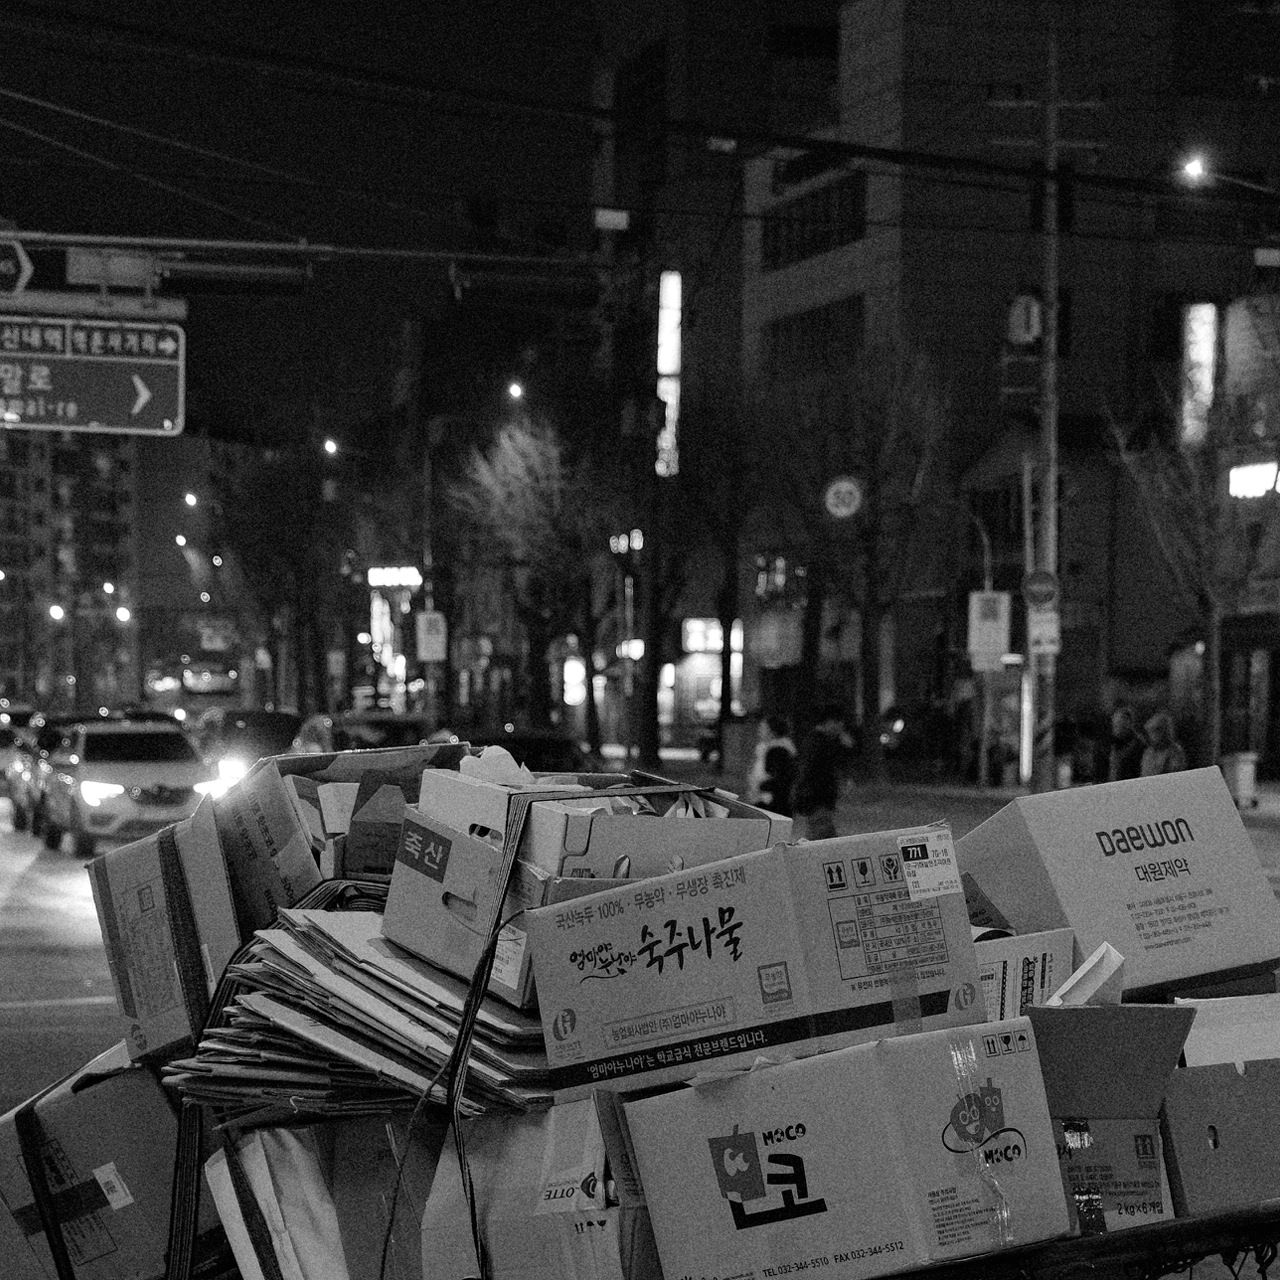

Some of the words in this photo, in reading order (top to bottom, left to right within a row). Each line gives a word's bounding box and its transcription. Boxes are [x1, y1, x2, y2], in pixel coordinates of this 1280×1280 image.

[405, 831, 443, 869] 축산
[1134, 857, 1192, 883] 대원제약
[555, 911, 595, 931] 국산녹두
[597, 900, 625, 921] 100%
[634, 887, 666, 911] 무농약
[676, 876, 710, 900] 무생장
[637, 906, 744, 976] 숙주나물
[762, 1123, 807, 1146] MOCO
[544, 1185, 580, 1201] OTTE
[763, 1266, 777, 1279] TEL
[778, 1257, 830, 1276] 032-344-5510
[834, 1252, 850, 1265] FAX
[851, 1240, 904, 1261] 032-344-5512
